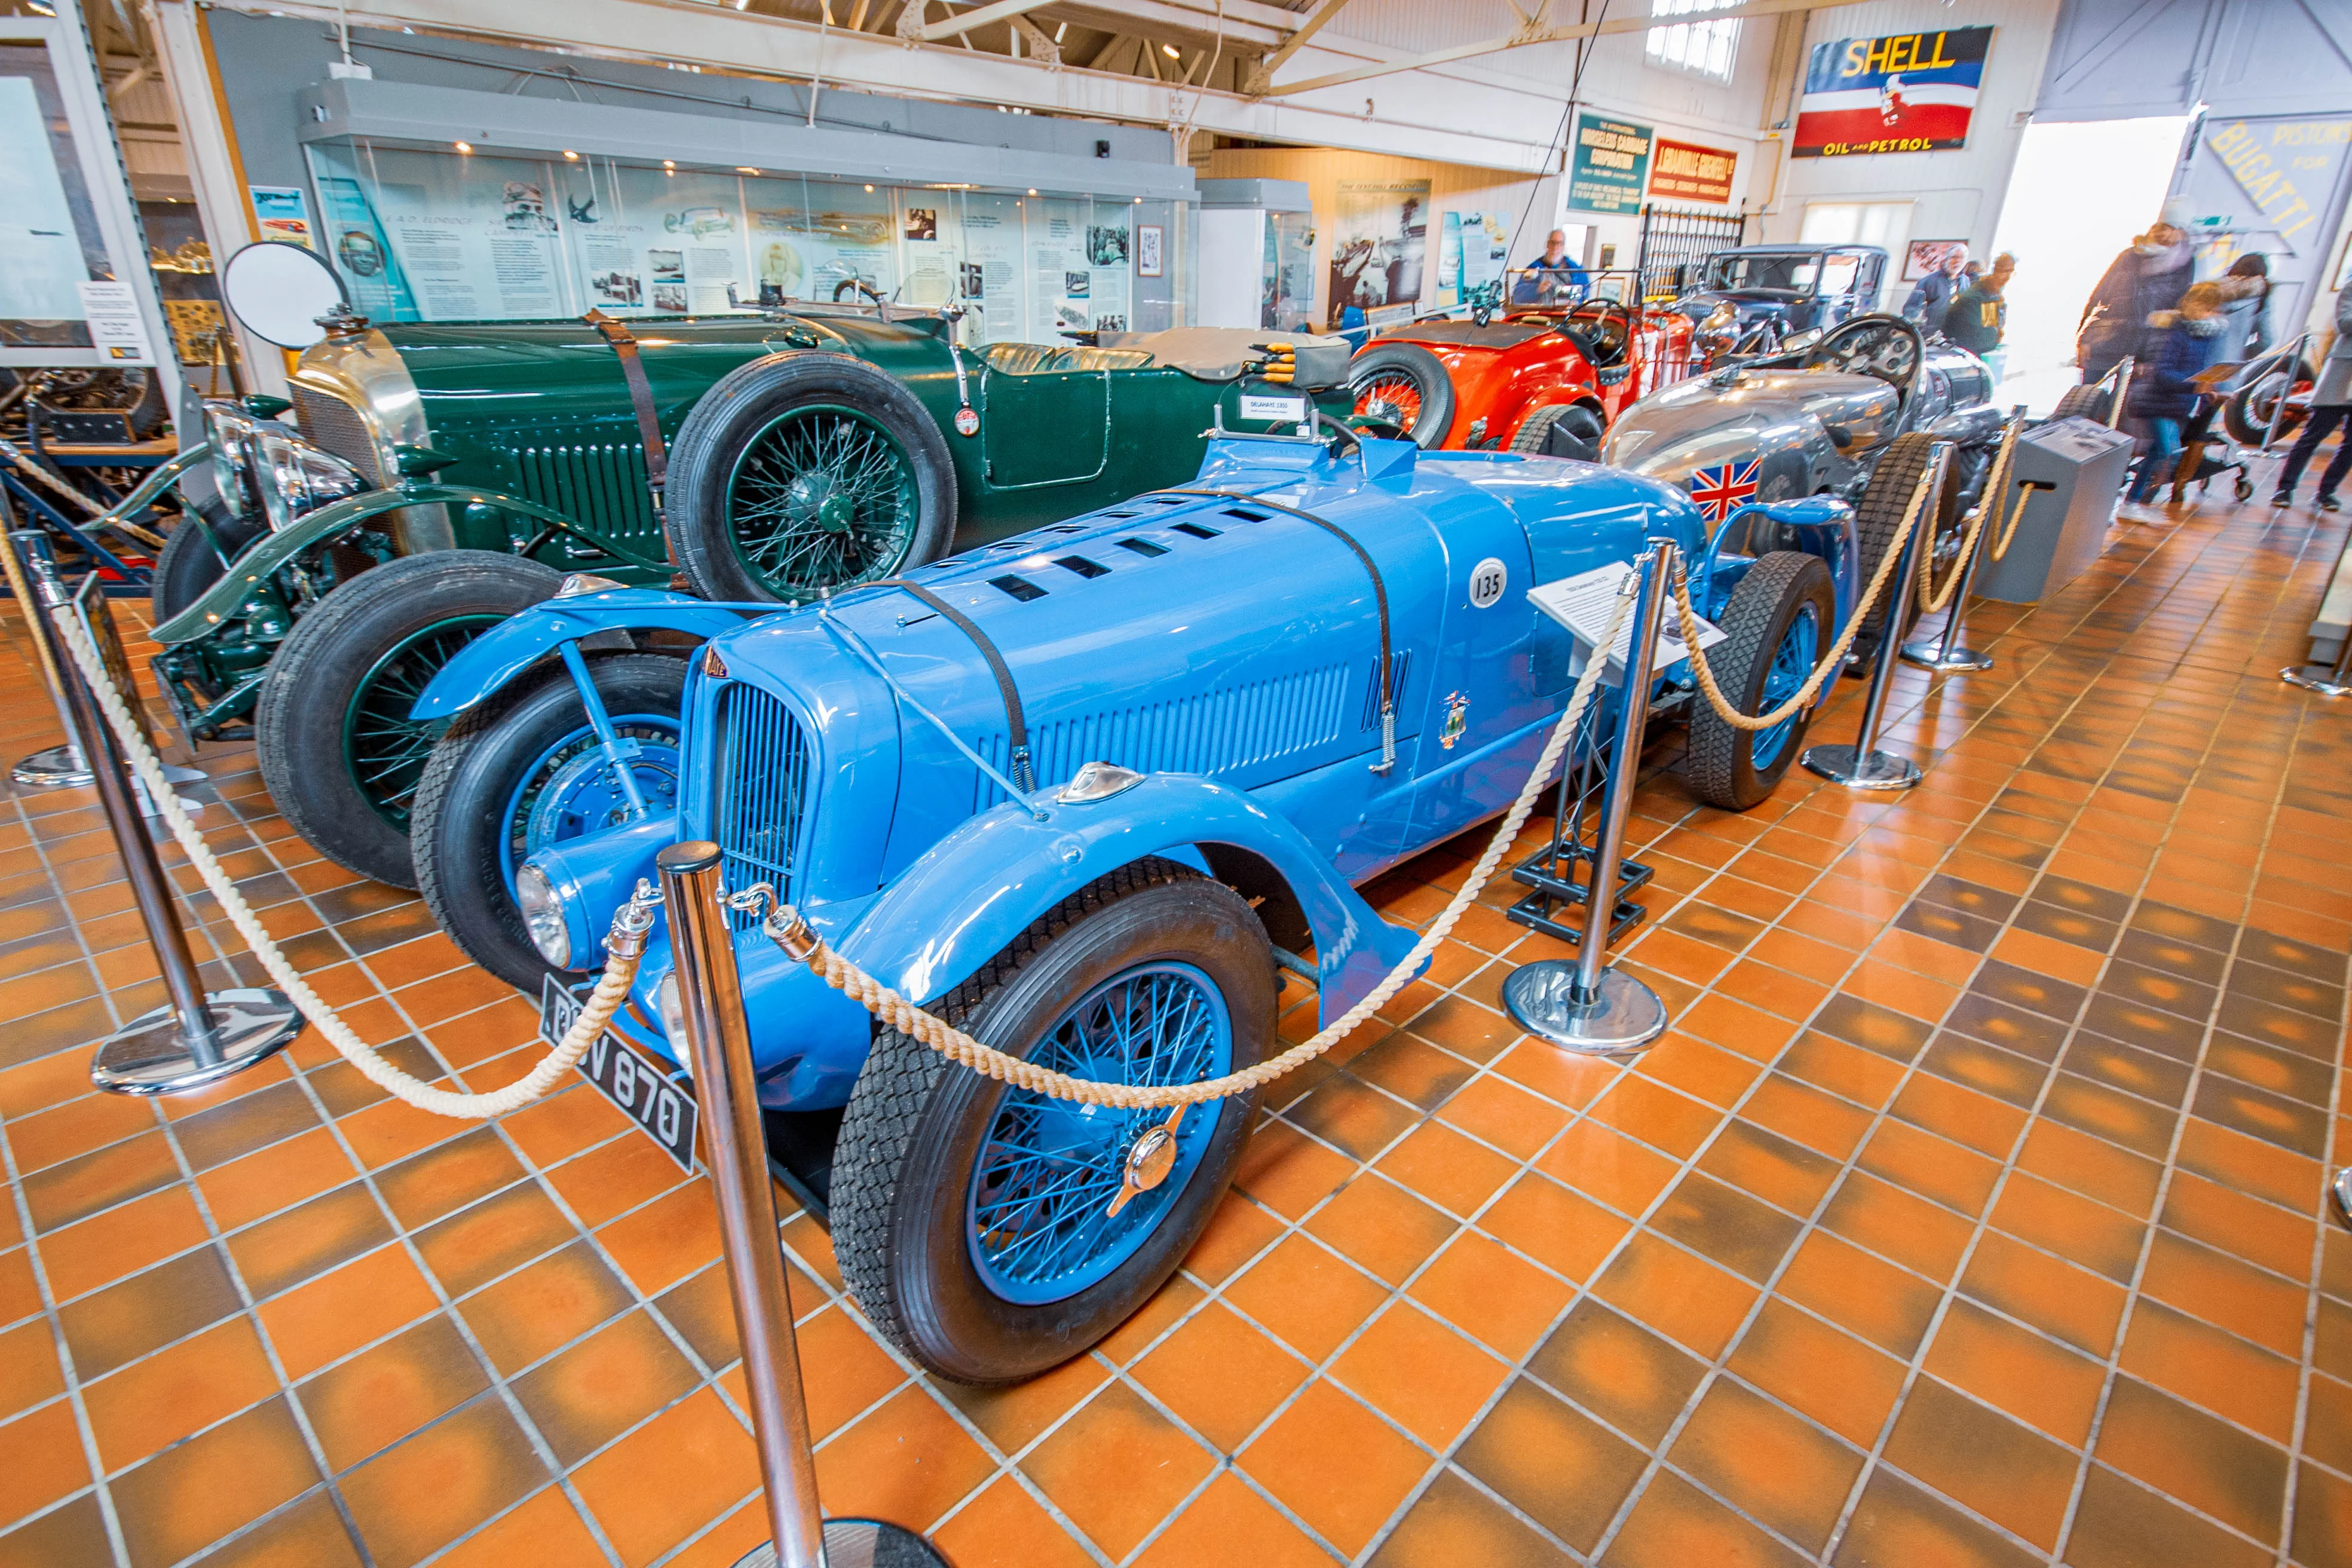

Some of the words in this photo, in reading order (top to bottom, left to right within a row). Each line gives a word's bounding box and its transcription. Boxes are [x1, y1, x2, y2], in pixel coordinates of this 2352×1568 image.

[1841, 31, 1956, 78] SHELL
[1823, 142, 1850, 155] OIL
[1868, 137, 1933, 153] PETROL
[2292, 155, 2330, 170] FOR
[2210, 120, 2316, 238] BUGATTI
[1477, 573, 1500, 599] 135
[613, 1049, 681, 1148] 870
